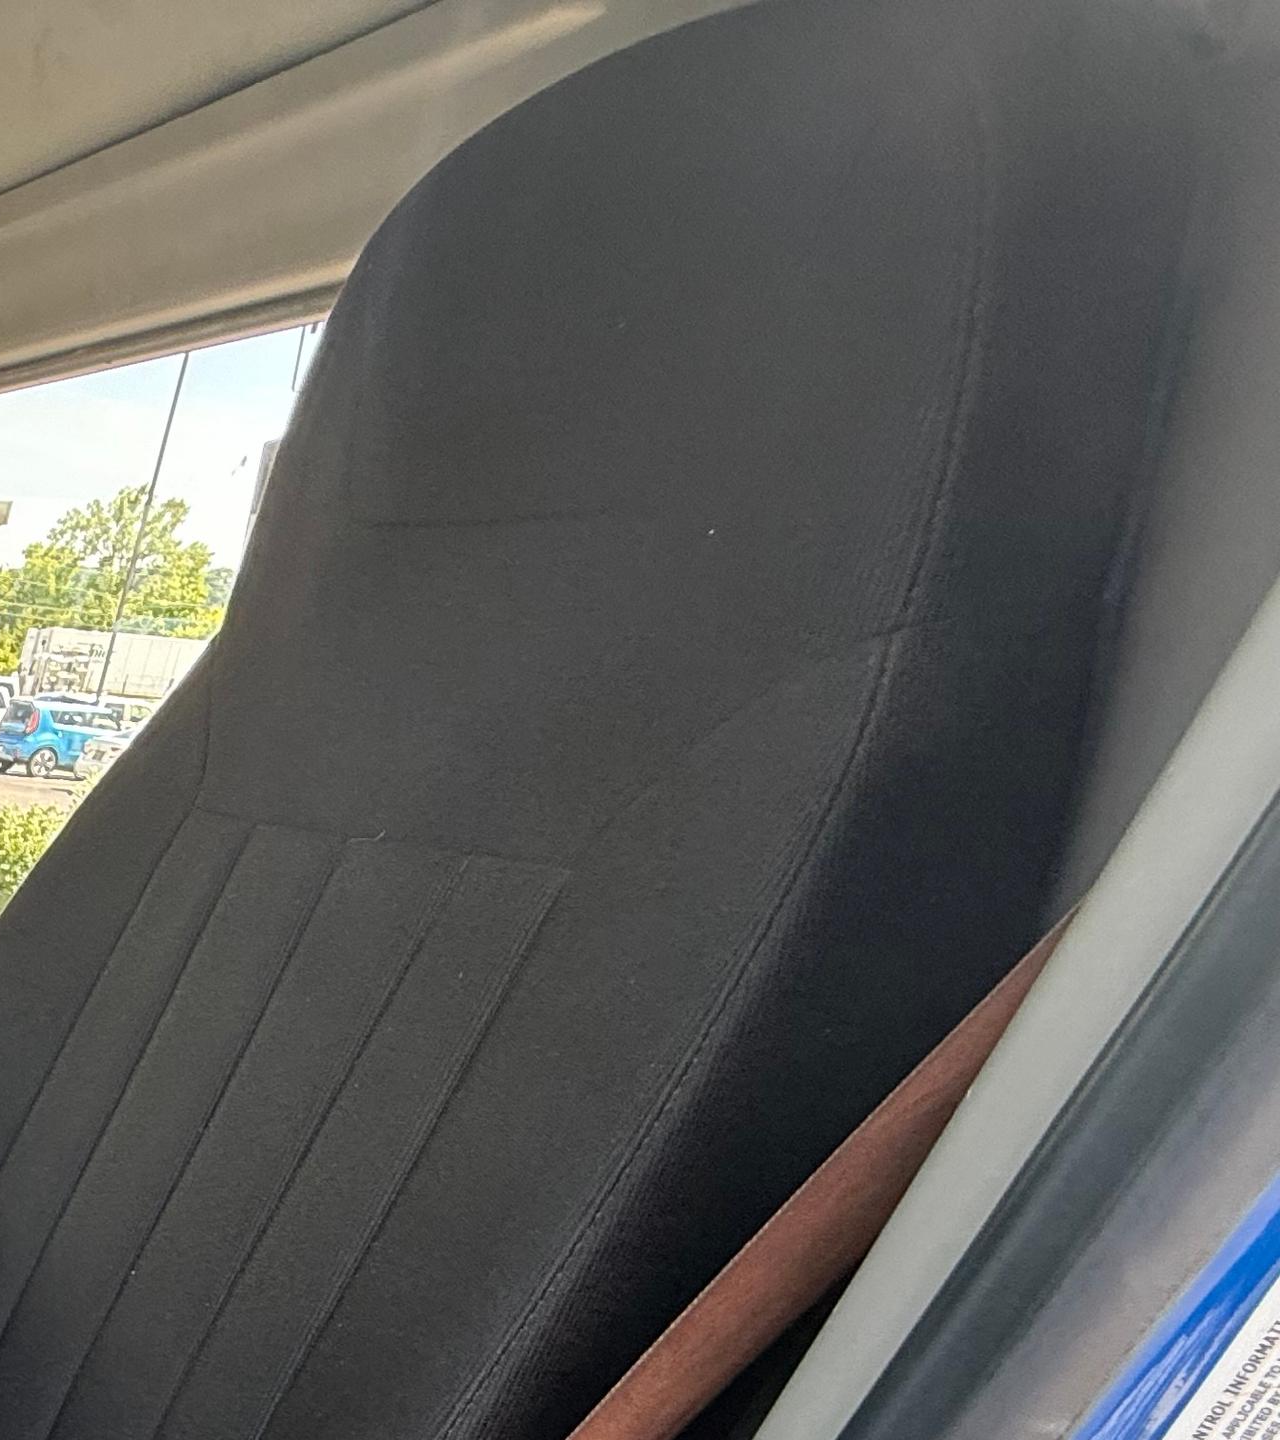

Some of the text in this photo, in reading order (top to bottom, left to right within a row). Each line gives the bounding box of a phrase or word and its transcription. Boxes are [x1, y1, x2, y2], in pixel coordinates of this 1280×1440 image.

[1221, 1379, 1272, 1440] APPLICABLE
[1264, 1363, 1280, 1379] TO
[1267, 1390, 1280, 1406] BY
